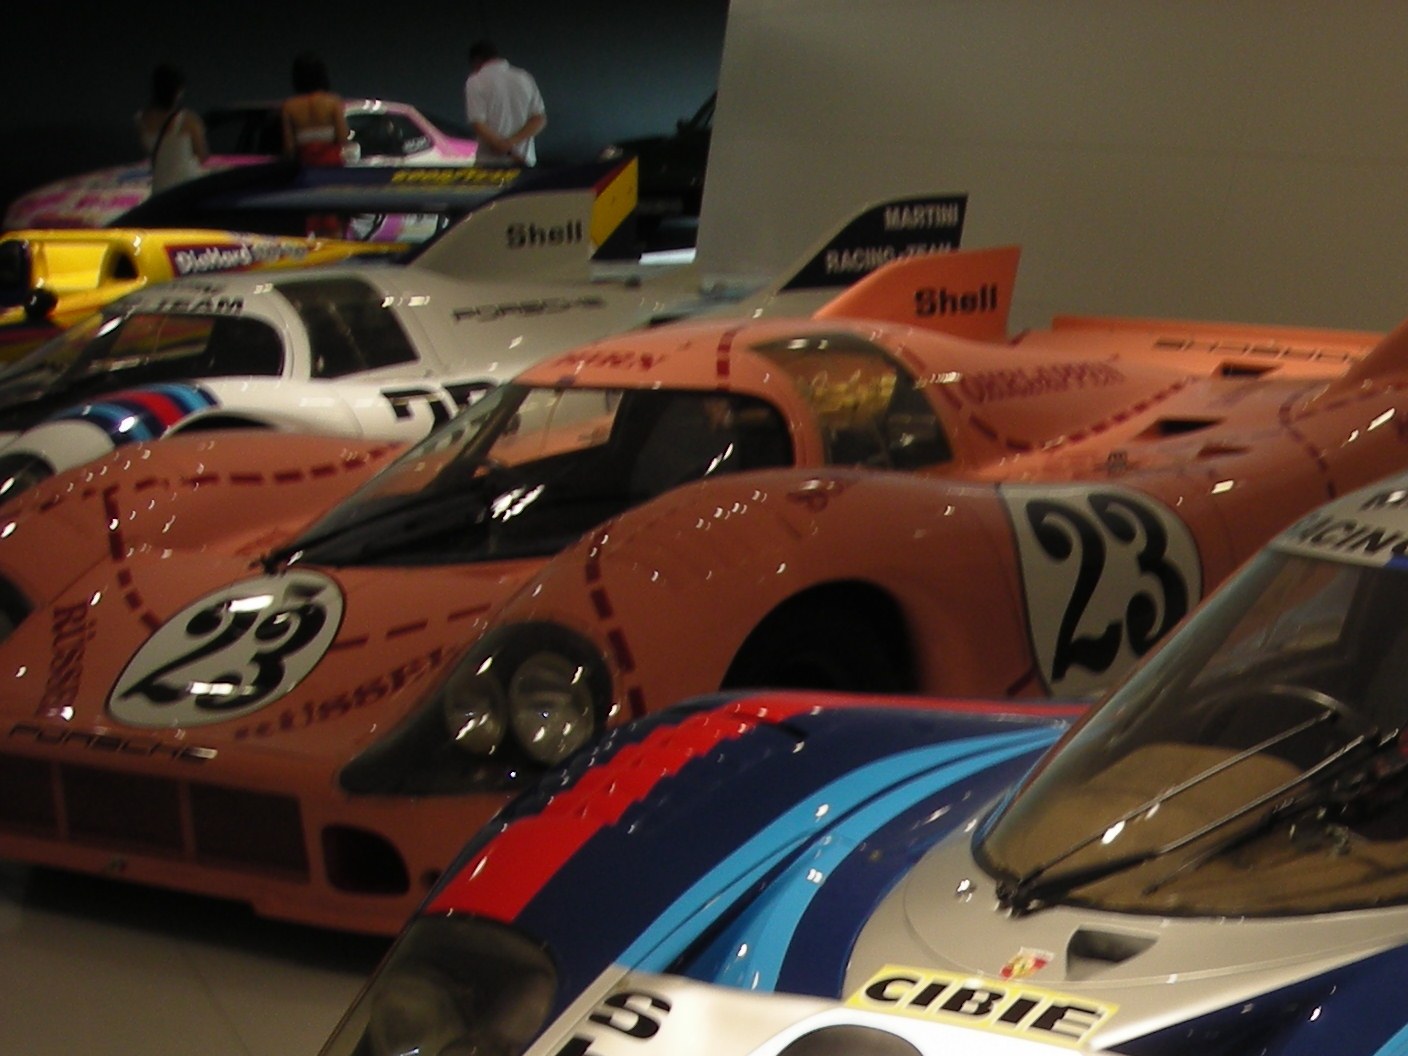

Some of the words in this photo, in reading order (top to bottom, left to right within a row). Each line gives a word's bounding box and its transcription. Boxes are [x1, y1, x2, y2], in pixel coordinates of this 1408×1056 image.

[506, 219, 583, 249] Shell
[883, 203, 960, 231] MARTINI
[914, 283, 998, 317] Shell
[1026, 491, 1191, 684] 23
[119, 580, 327, 711] 23
[865, 977, 1103, 1040] CIBIE
